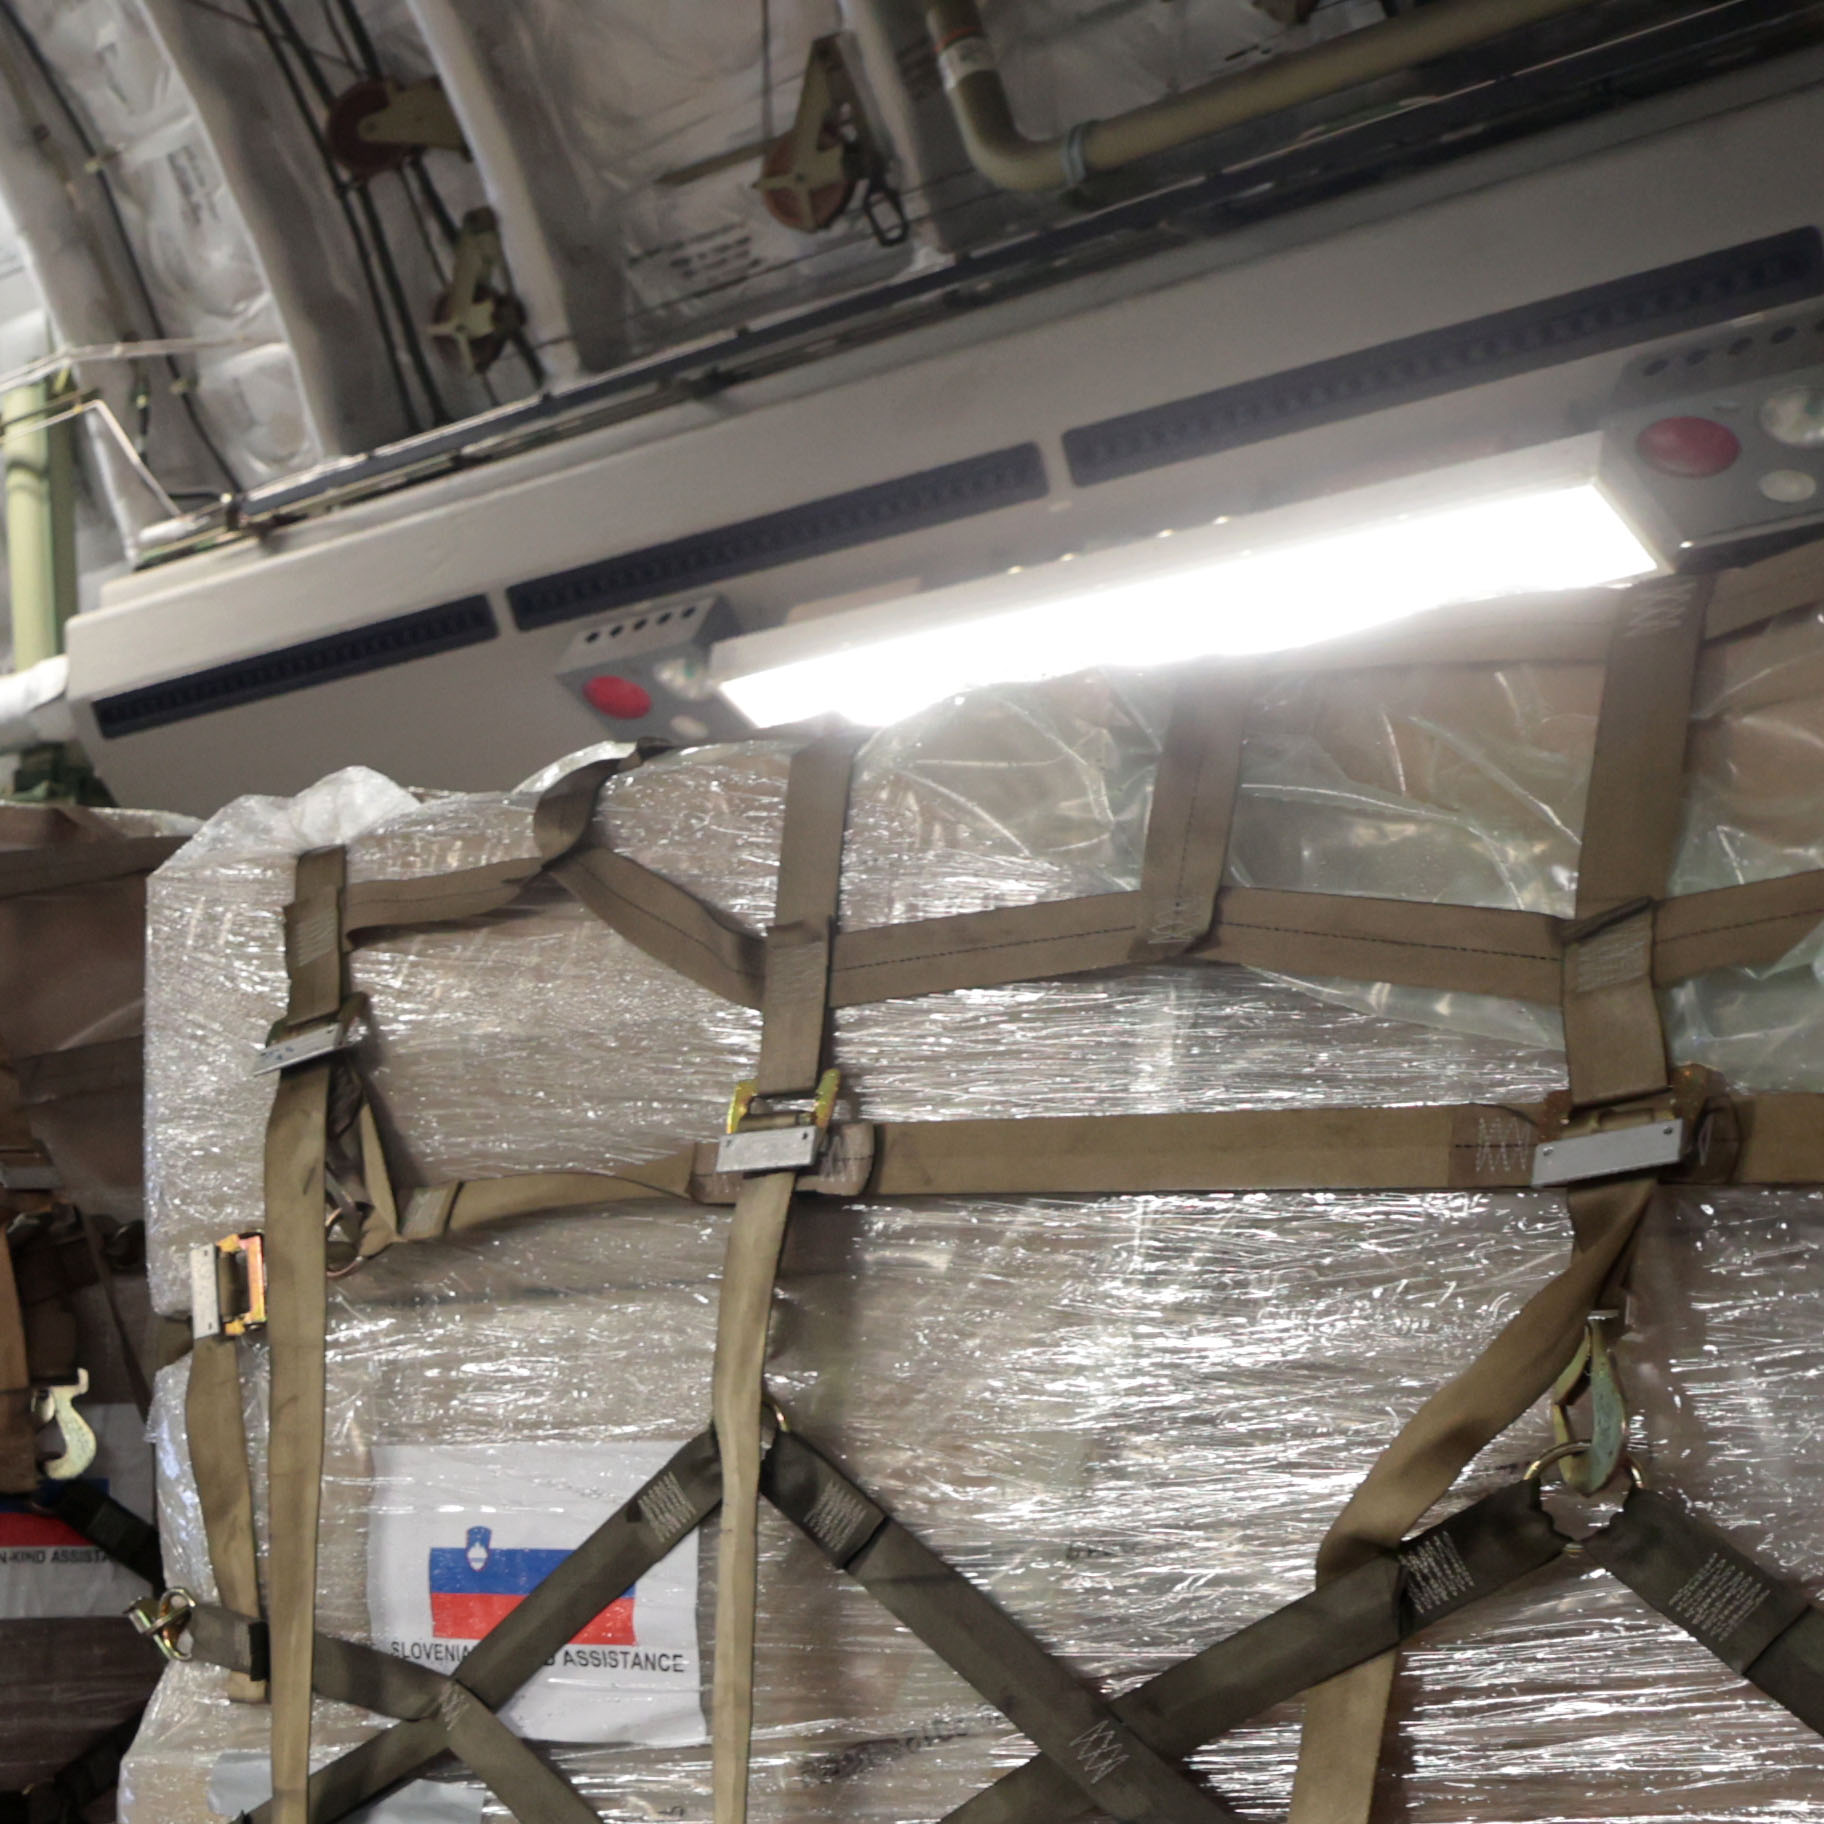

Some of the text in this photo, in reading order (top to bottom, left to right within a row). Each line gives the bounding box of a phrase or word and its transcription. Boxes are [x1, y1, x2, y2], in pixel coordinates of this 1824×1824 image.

[50, 1551, 110, 1564] ASSISTA
[391, 1641, 470, 1662] SLOVENIA
[563, 1650, 685, 1673] ASSISTANCE
